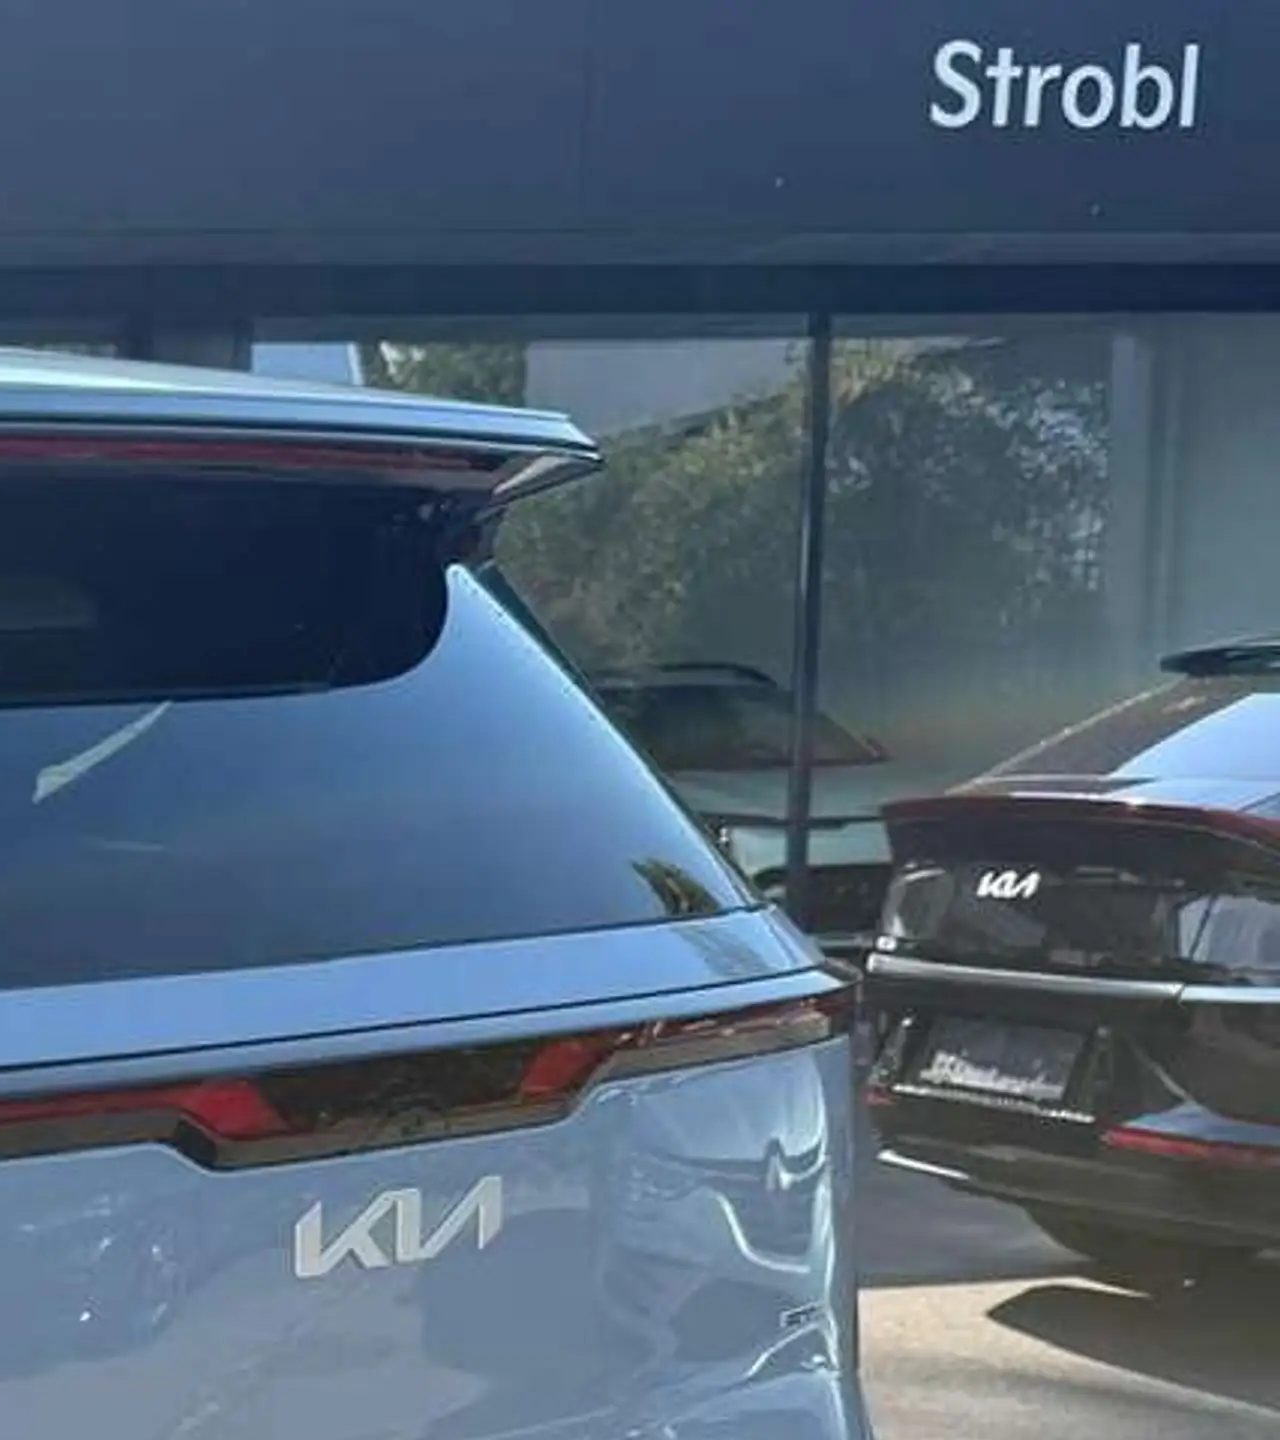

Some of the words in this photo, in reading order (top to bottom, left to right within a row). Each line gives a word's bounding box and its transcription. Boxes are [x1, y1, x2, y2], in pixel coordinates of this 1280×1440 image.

[929, 40, 1200, 129] Strobl
[977, 869, 1041, 898] KIA
[294, 1175, 502, 1278] KIA
